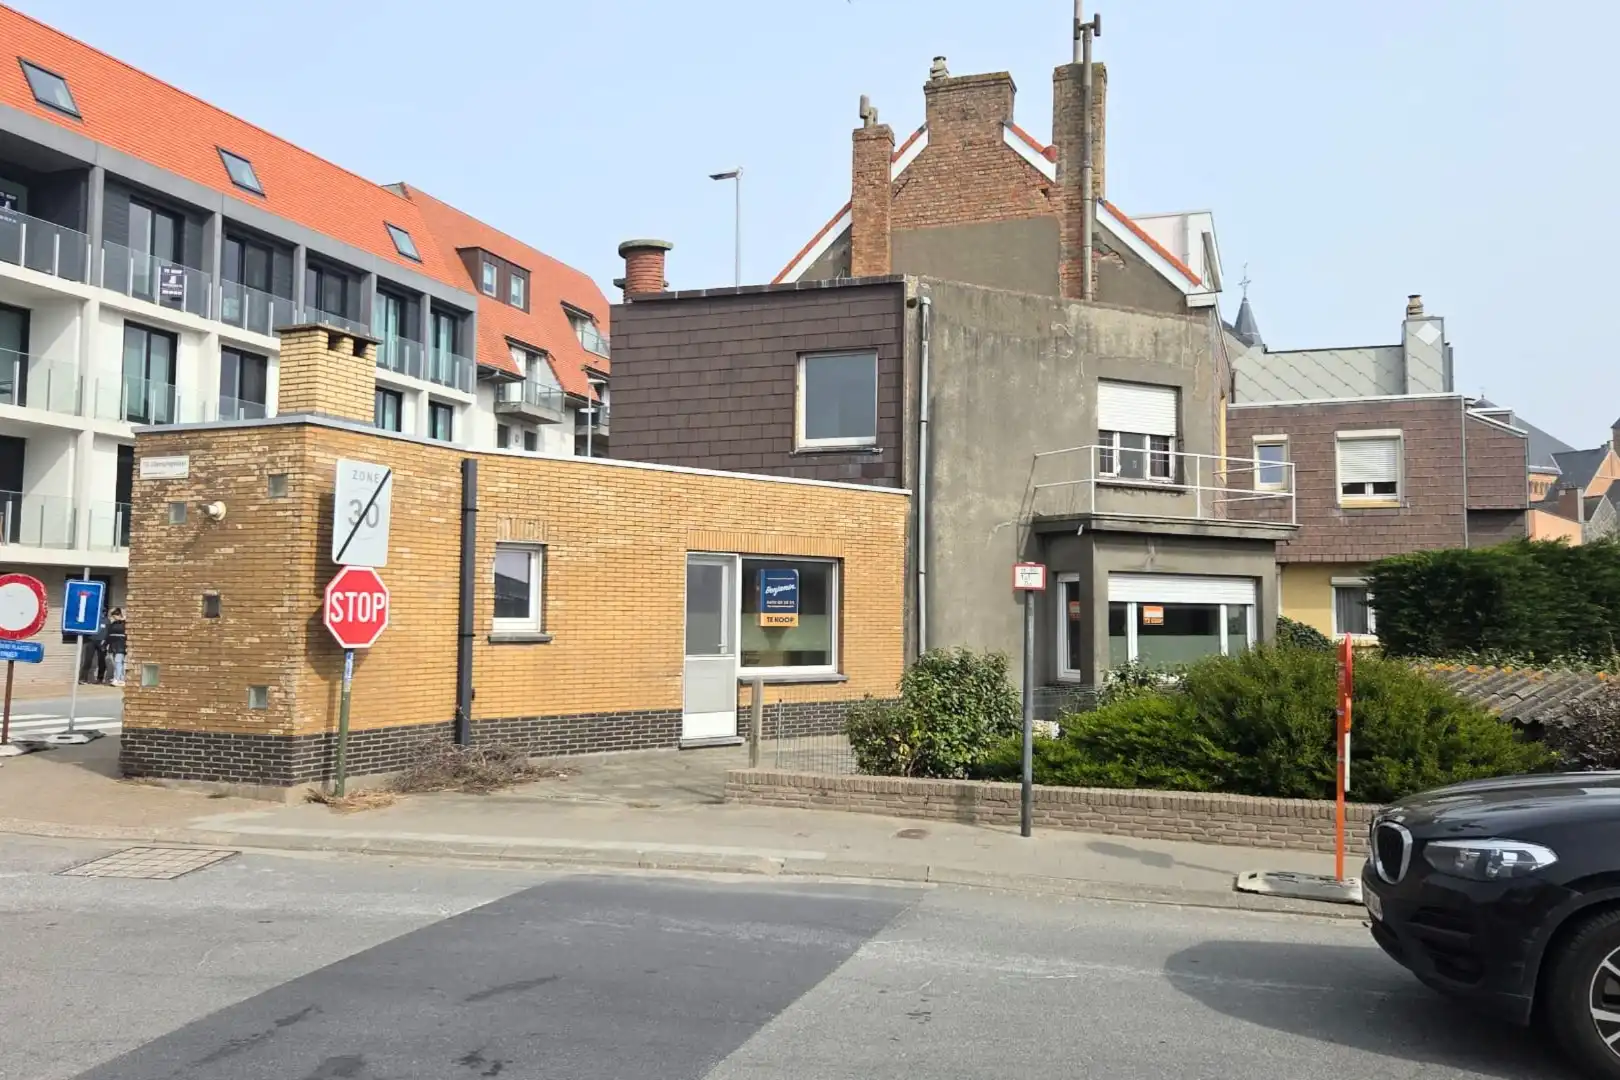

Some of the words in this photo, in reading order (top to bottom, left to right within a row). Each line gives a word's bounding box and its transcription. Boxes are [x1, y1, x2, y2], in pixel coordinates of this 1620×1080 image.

[351, 469, 380, 484] ZONE
[348, 499, 380, 529] 30
[330, 591, 386, 623] STOP
